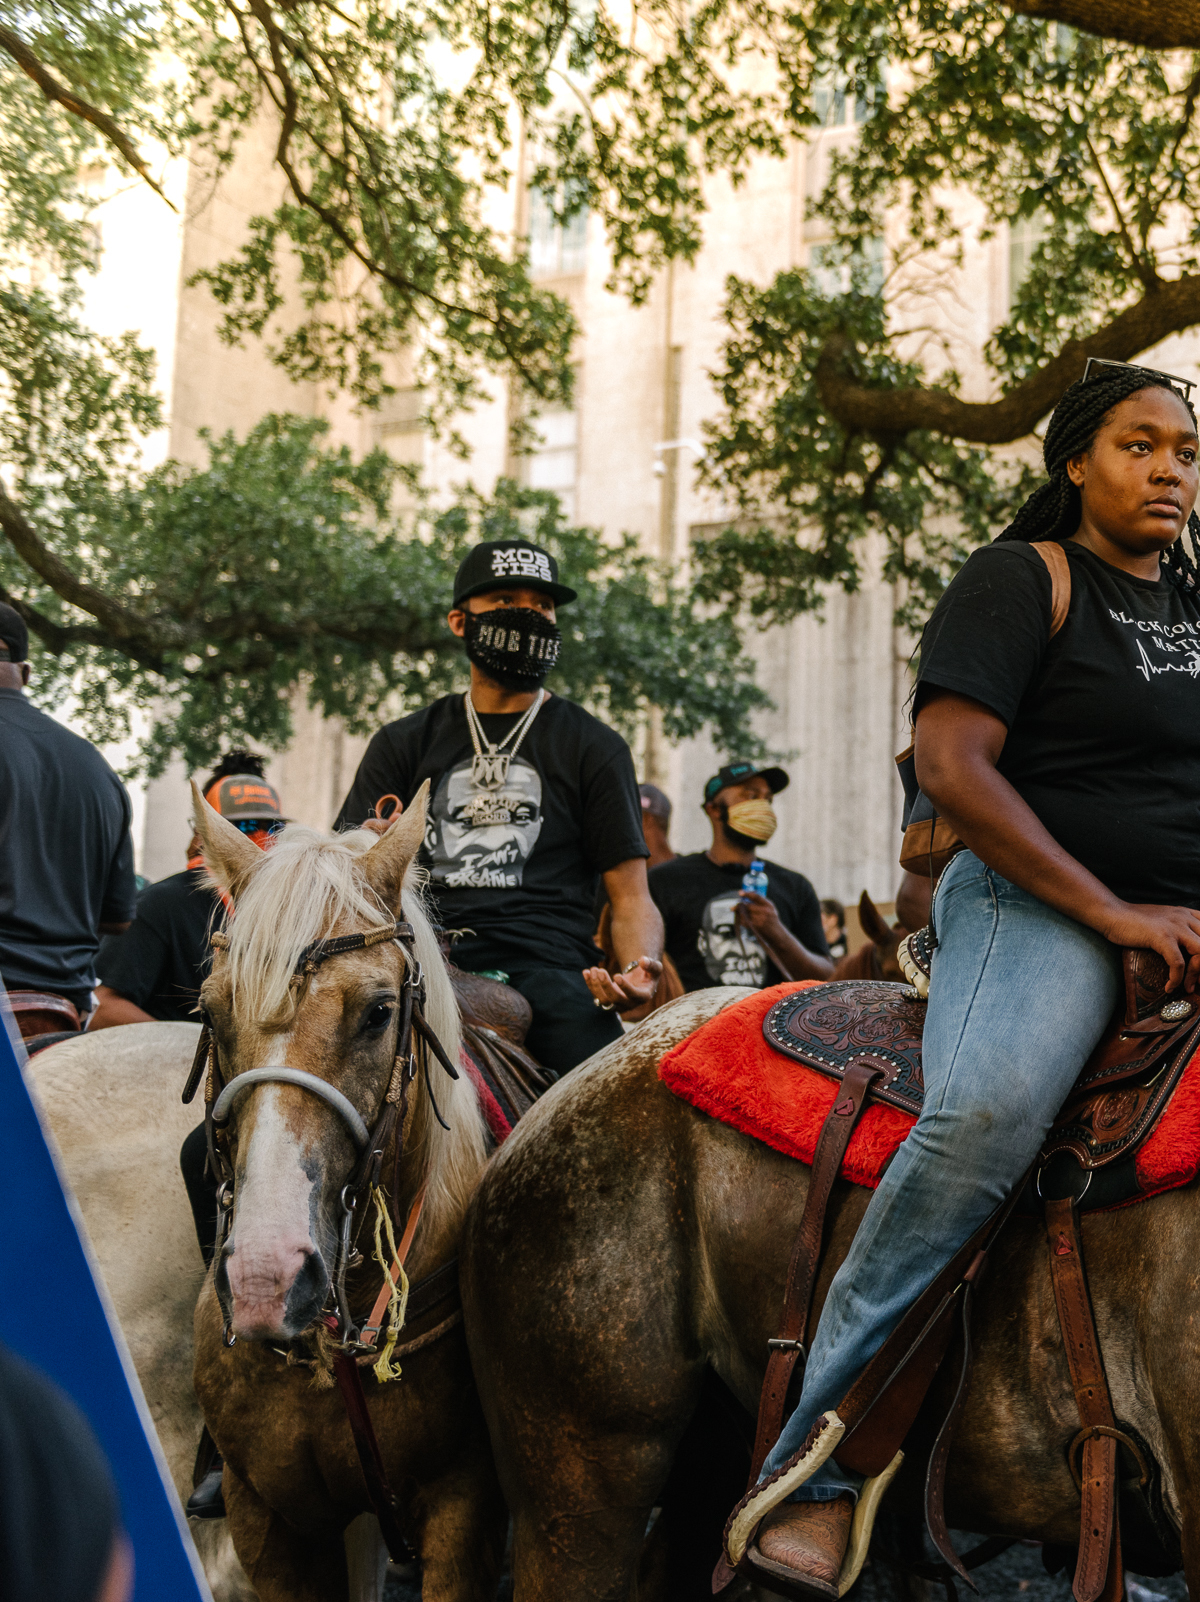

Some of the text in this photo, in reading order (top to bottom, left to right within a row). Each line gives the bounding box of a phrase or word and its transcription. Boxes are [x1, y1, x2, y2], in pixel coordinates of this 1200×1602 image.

[492, 548, 550, 569] MOB
[491, 562, 552, 582] TIES
[1108, 608, 1164, 634] BLCK
[478, 624, 521, 653] MOB
[459, 853, 483, 872] I
[444, 867, 517, 888] BREATHE
